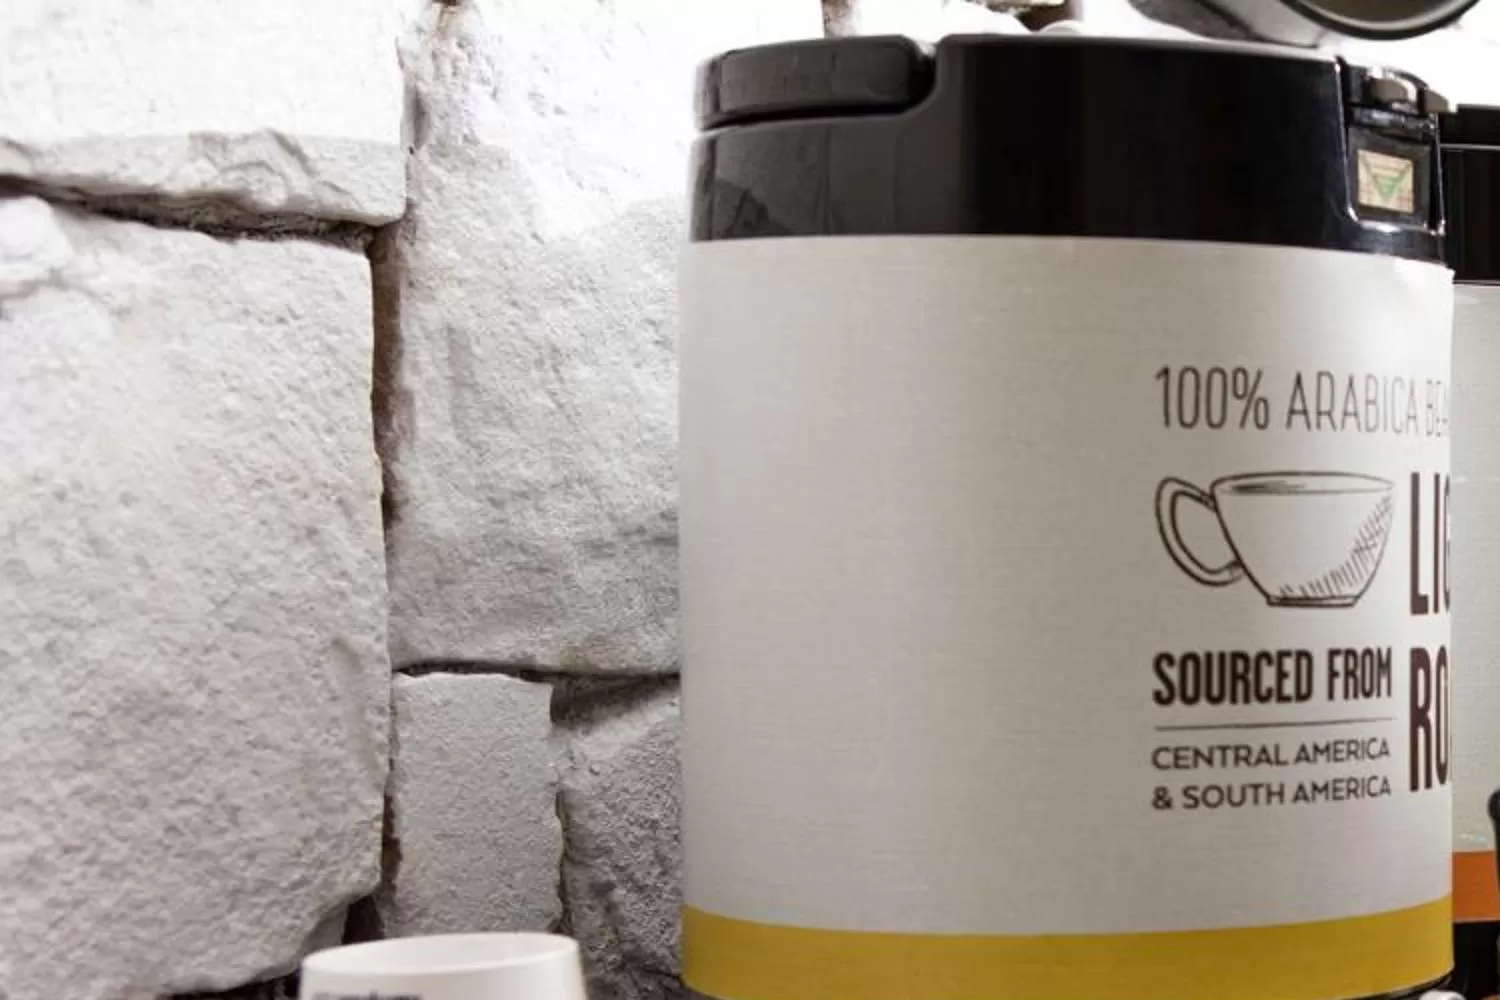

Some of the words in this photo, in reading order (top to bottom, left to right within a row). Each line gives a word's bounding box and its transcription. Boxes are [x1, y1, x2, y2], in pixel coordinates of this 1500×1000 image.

[1155, 365, 1269, 431] 100%
[1286, 371, 1420, 435] ARABICA
[1152, 650, 1314, 708] SOURCED
[1327, 646, 1393, 702] FROM
[1151, 742, 1289, 773] CENTRAL
[1293, 737, 1391, 767] AMERICA
[1151, 786, 1173, 811] &
[1183, 782, 1285, 810] SOUTH
[1292, 775, 1391, 804] AMERICA
